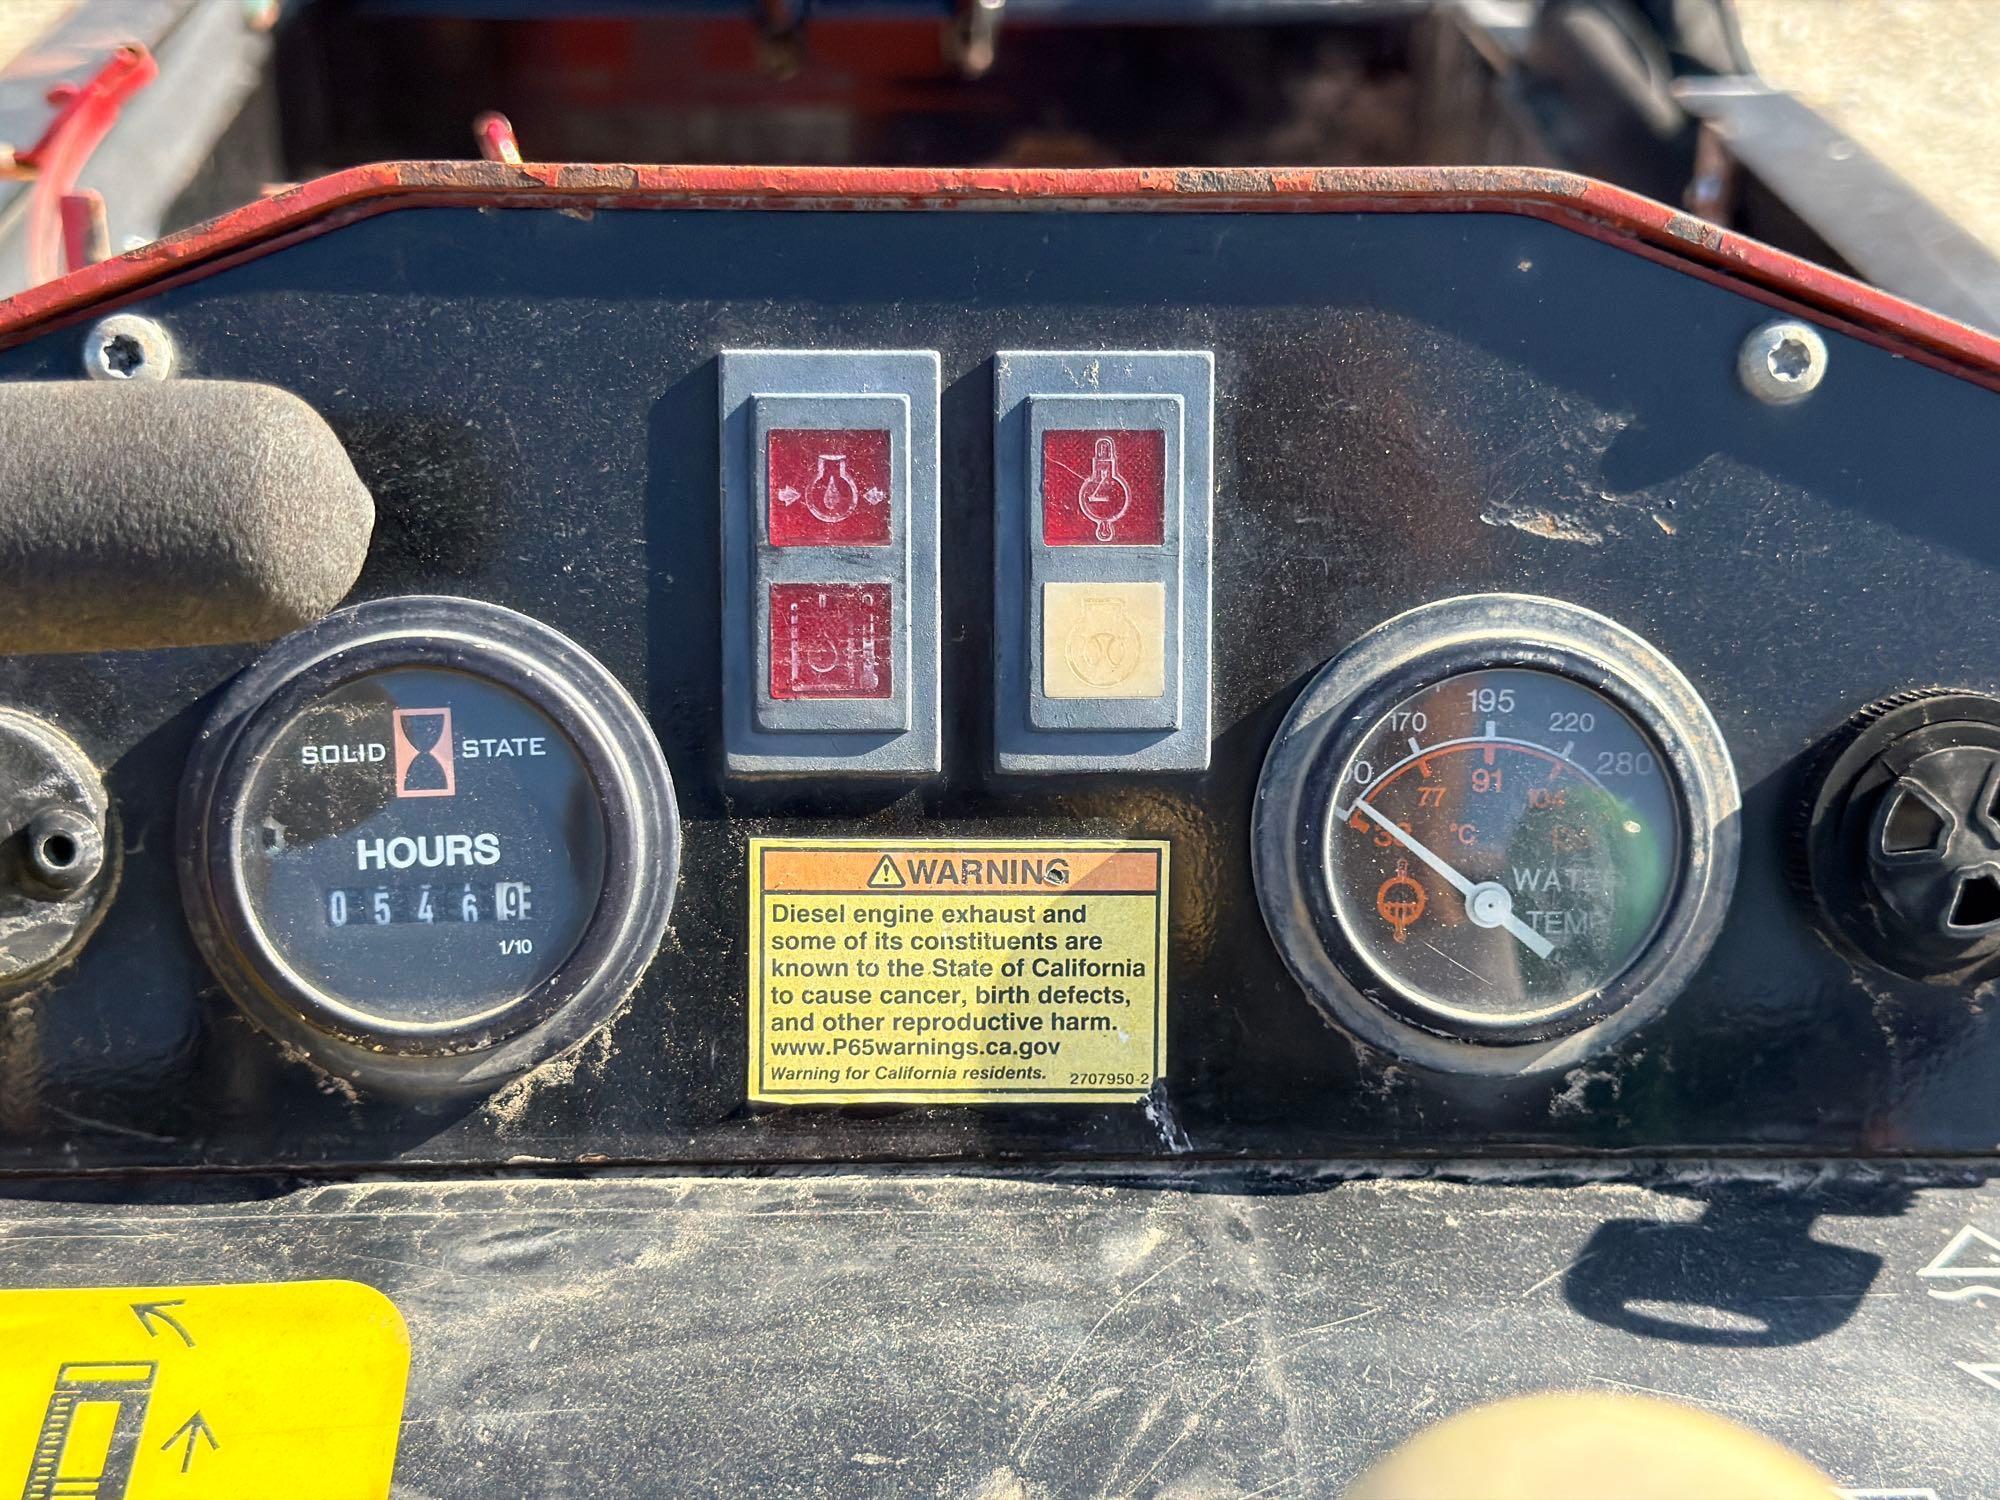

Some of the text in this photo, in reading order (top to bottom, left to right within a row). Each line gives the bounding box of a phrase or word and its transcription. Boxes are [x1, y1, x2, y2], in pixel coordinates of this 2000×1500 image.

[1467, 688, 1515, 713] 195
[1389, 712, 1427, 732] 170
[1549, 712, 1594, 732] 220
[301, 743, 386, 765] SOLID
[462, 737, 546, 759] STATE
[1596, 751, 1650, 776] 280
[1472, 768, 1502, 793] 91
[1417, 787, 1447, 807] 77
[357, 833, 501, 871] HOURS
[907, 859, 1070, 885] WARNING
[771, 904, 1087, 928] Diesel engine exhaust and
[499, 939, 533, 955] 1/10
[771, 931, 1103, 951] some of its constituents are
[771, 957, 1146, 977] known to the State of California
[771, 986, 1131, 1009] to cause cancer, birth defects,
[771, 1013, 1118, 1037] and other reproductive harm.
[771, 1039, 1060, 1061] www.P65warnings.ca.gov
[771, 1065, 1046, 1083] Warning for California residents.
[1070, 1073, 1149, 1086] 2707950-2
